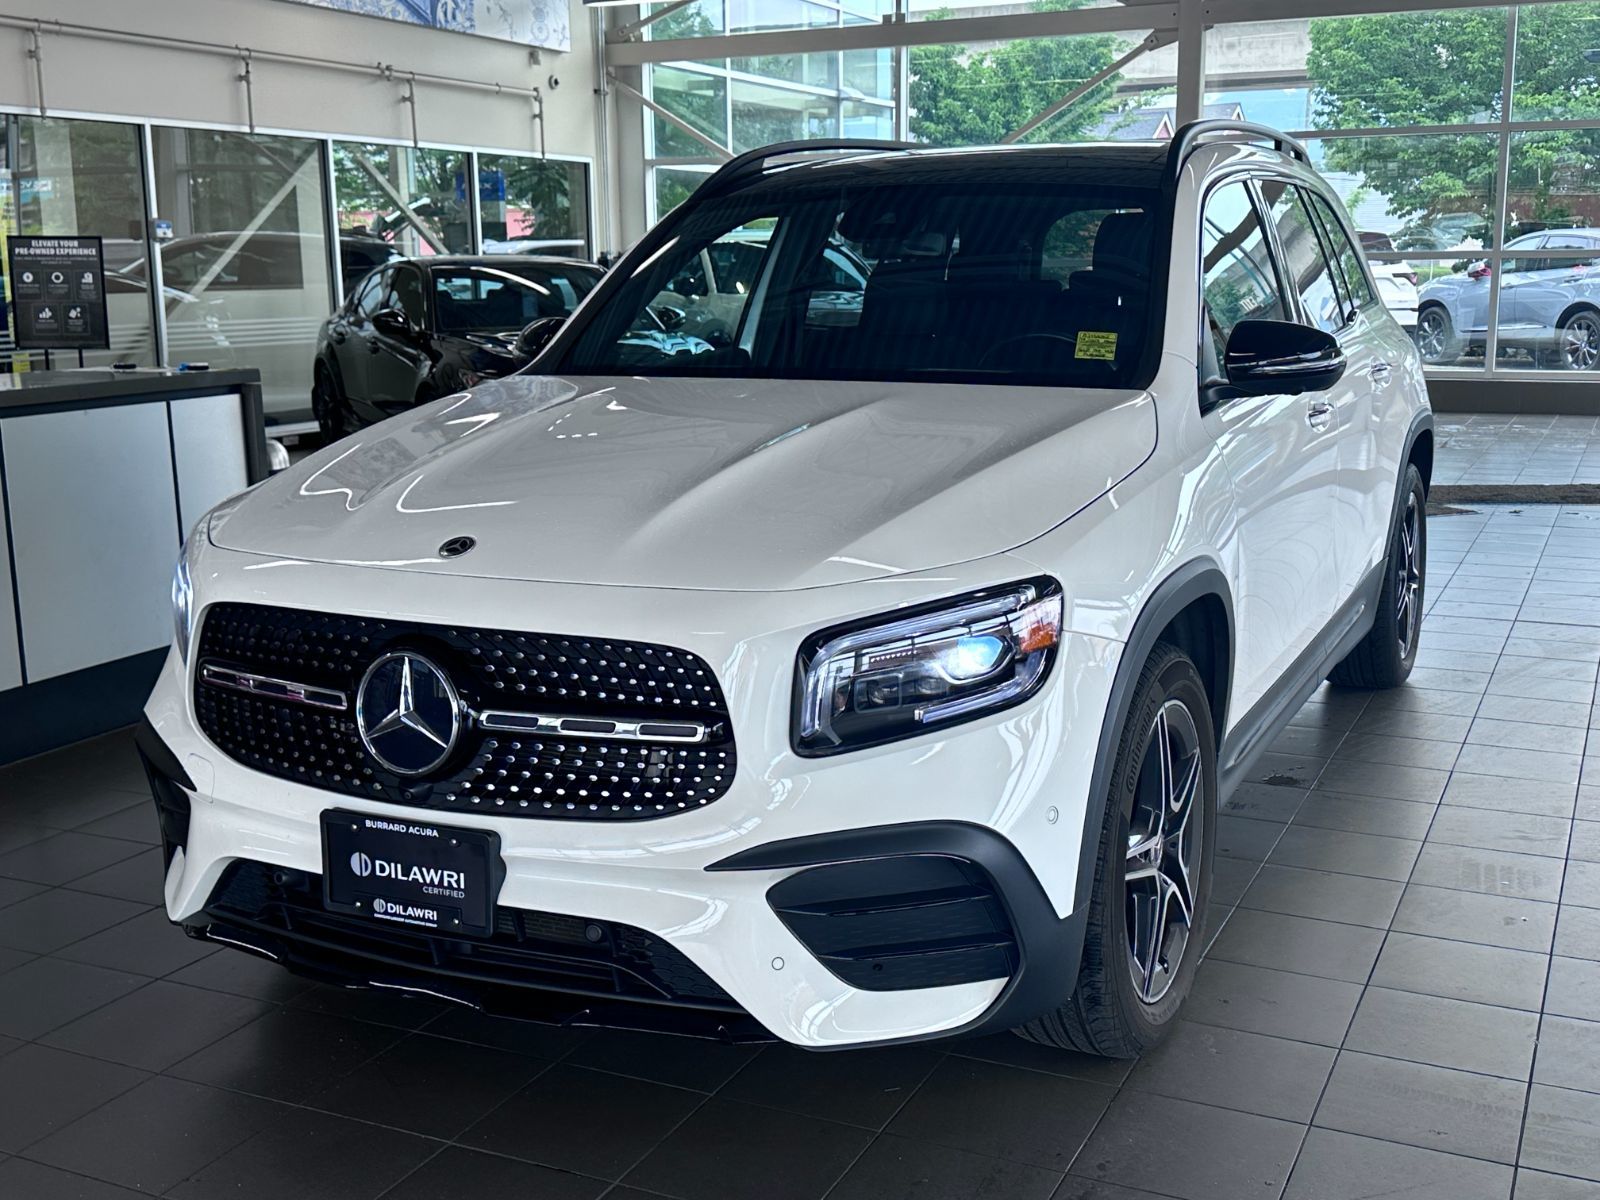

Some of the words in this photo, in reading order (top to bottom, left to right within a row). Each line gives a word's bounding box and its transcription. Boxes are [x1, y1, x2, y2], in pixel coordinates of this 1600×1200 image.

[15, 247, 55, 255] PRE-OWNED
[31, 240, 58, 248] ELEVATE
[60, 240, 78, 248] YOUR
[1126, 704, 1155, 794] Continental
[365, 819, 406, 833] BURRARD
[408, 826, 439, 838] ACURA
[375, 859, 465, 889] DILAWRI
[422, 886, 465, 898] CERTIFIED
[387, 903, 437, 921] DILAWRI
